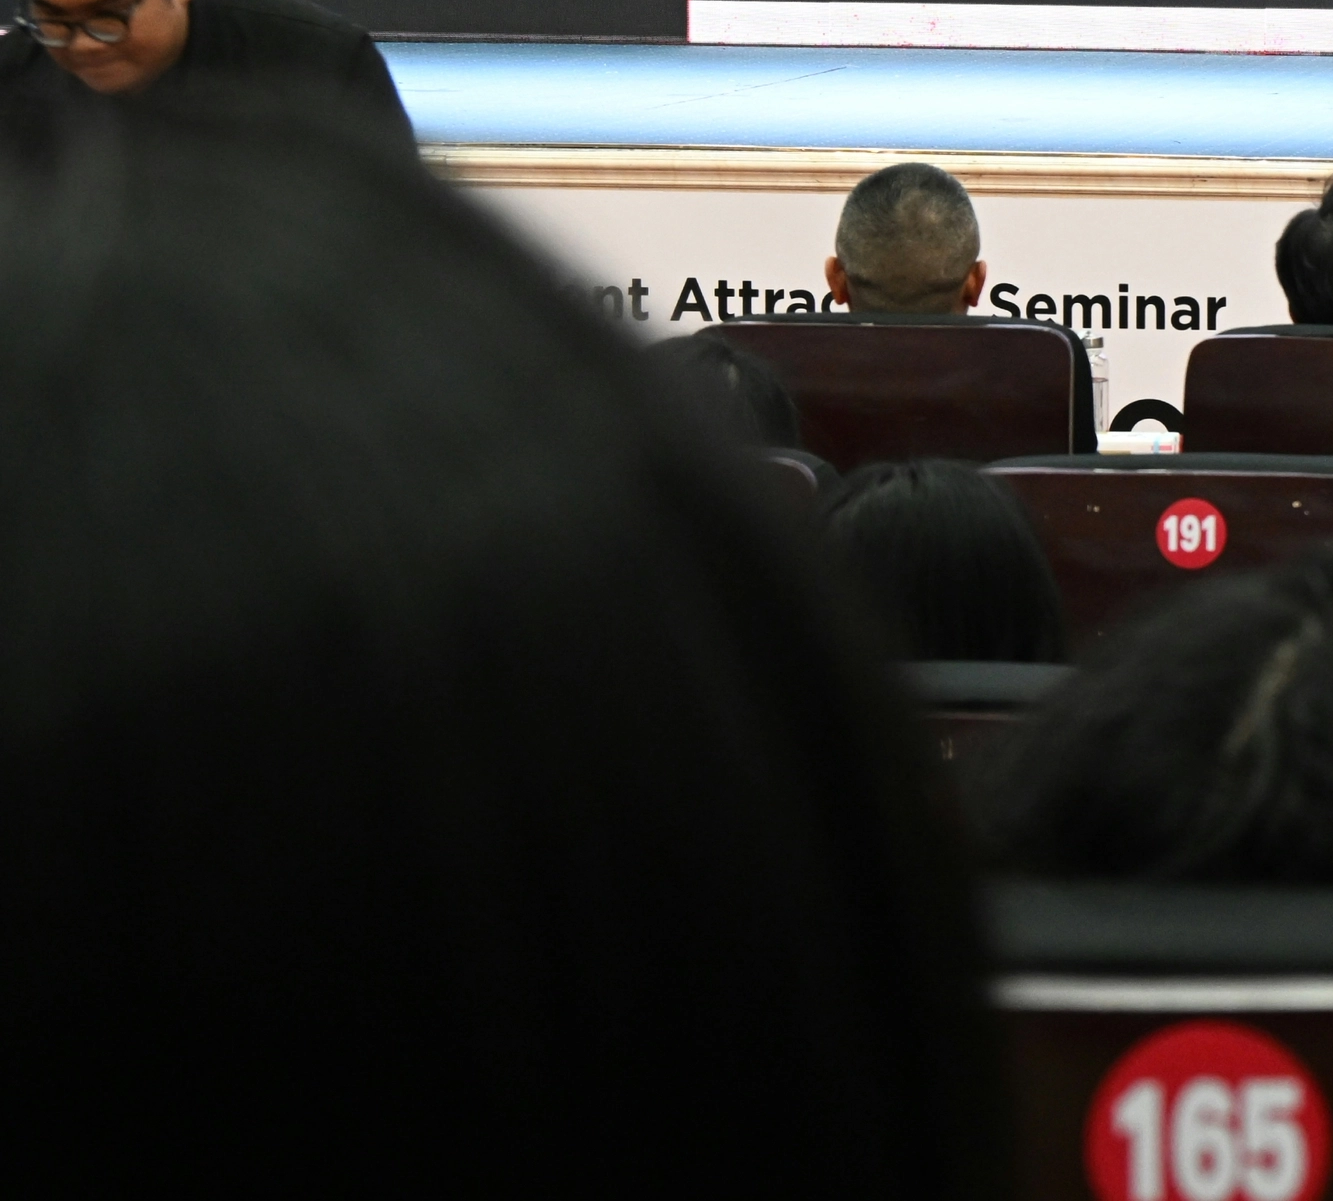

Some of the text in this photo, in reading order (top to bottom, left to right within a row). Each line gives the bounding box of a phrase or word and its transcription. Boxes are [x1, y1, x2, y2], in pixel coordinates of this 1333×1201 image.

[988, 281, 1228, 333] Seminar
[1162, 513, 1217, 554] 191
[1112, 1077, 1307, 1201] 165
